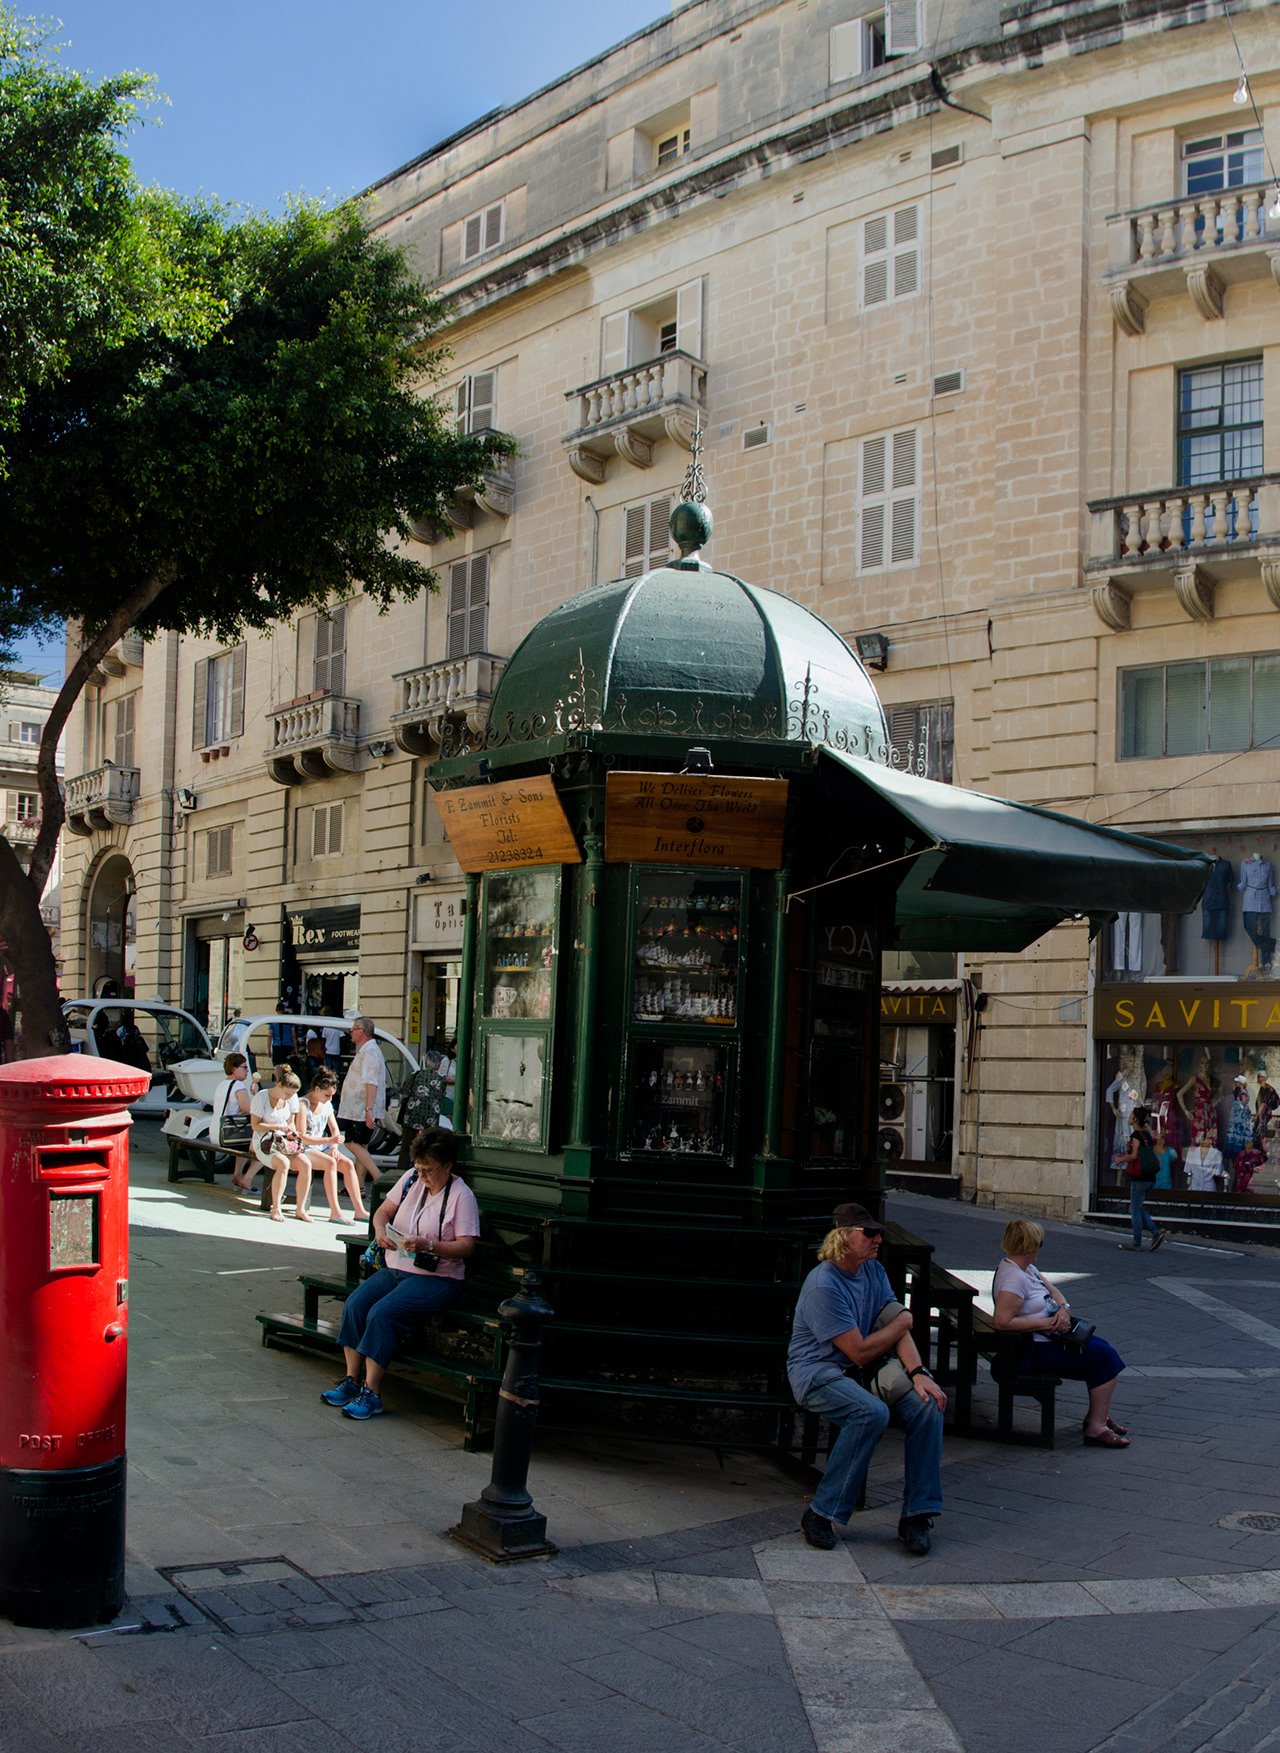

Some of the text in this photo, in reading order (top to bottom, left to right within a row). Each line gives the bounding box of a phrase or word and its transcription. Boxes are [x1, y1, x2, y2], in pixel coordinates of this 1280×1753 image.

[639, 781, 754, 799] We Deliver Flowers
[444, 788, 544, 813] F. Zammit & Sons
[635, 797, 758, 814] All Over The World
[479, 812, 521, 827] Florists
[496, 829, 518, 844] Tel:
[487, 847, 543, 863] 21238324
[654, 837, 725, 858] Interflora
[291, 925, 326, 946] Rex
[19, 1424, 116, 1451] POST OFFICE
